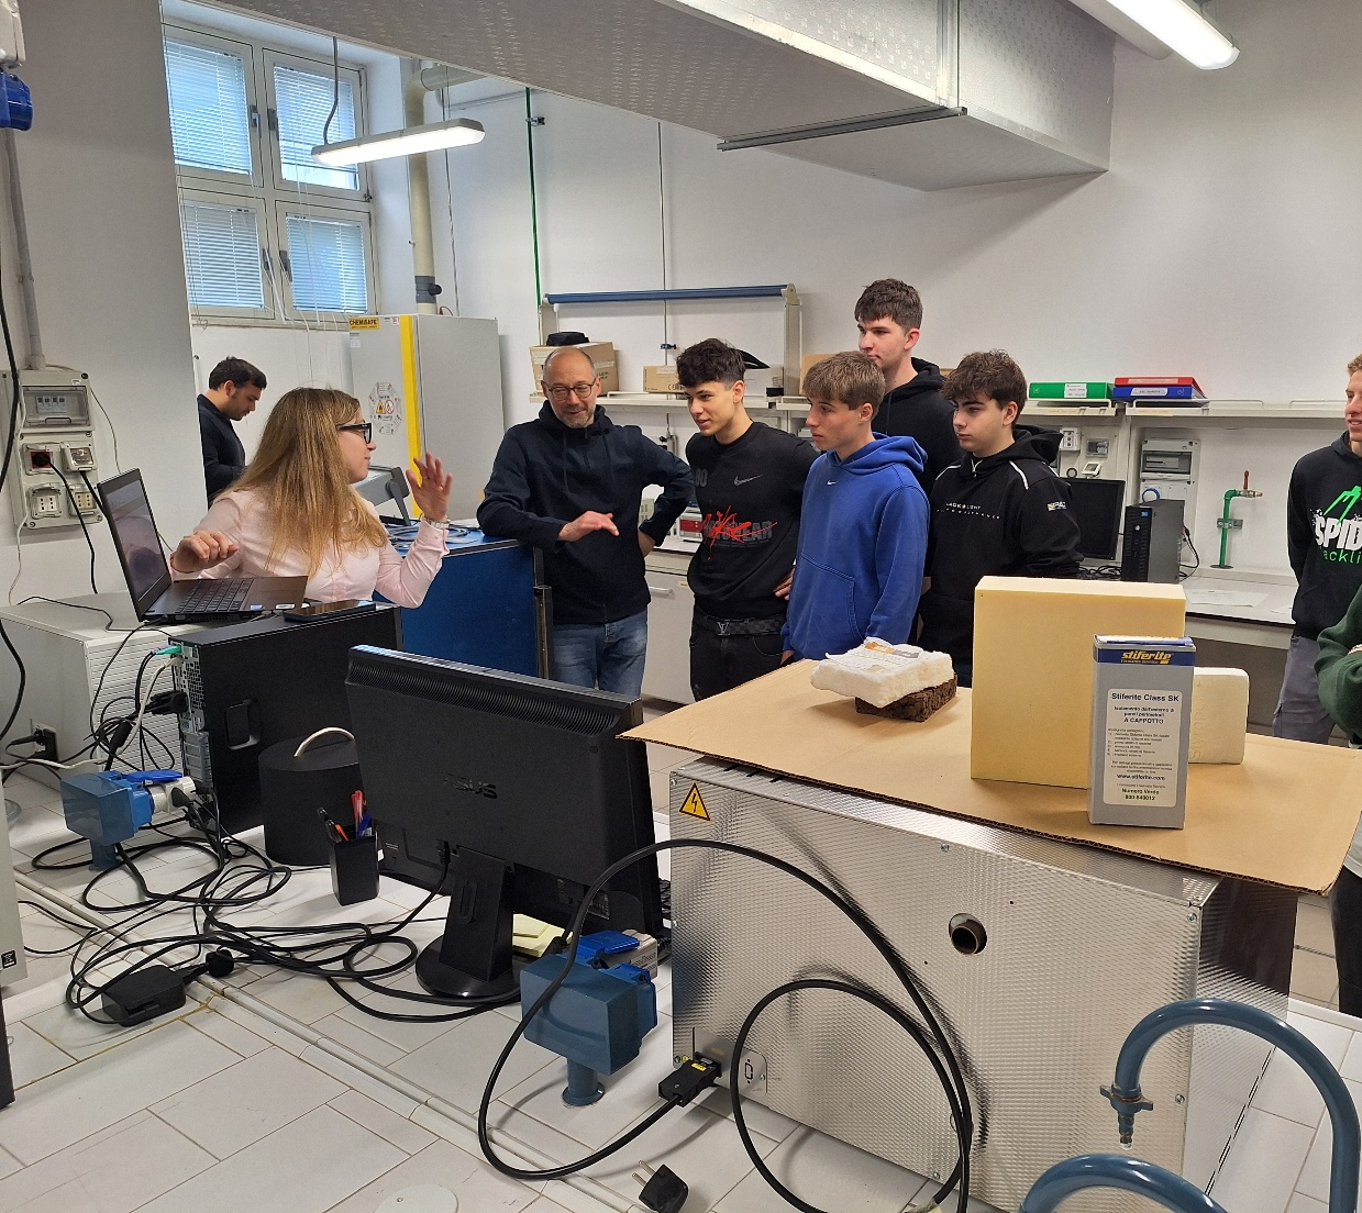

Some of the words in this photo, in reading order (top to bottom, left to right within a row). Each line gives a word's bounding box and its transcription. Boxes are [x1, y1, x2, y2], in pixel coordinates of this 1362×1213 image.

[1121, 651, 1172, 660] stiferite
[1111, 692, 1142, 701] Stiferite
[1143, 693, 1166, 702] Class
[1167, 694, 1180, 702] SK
